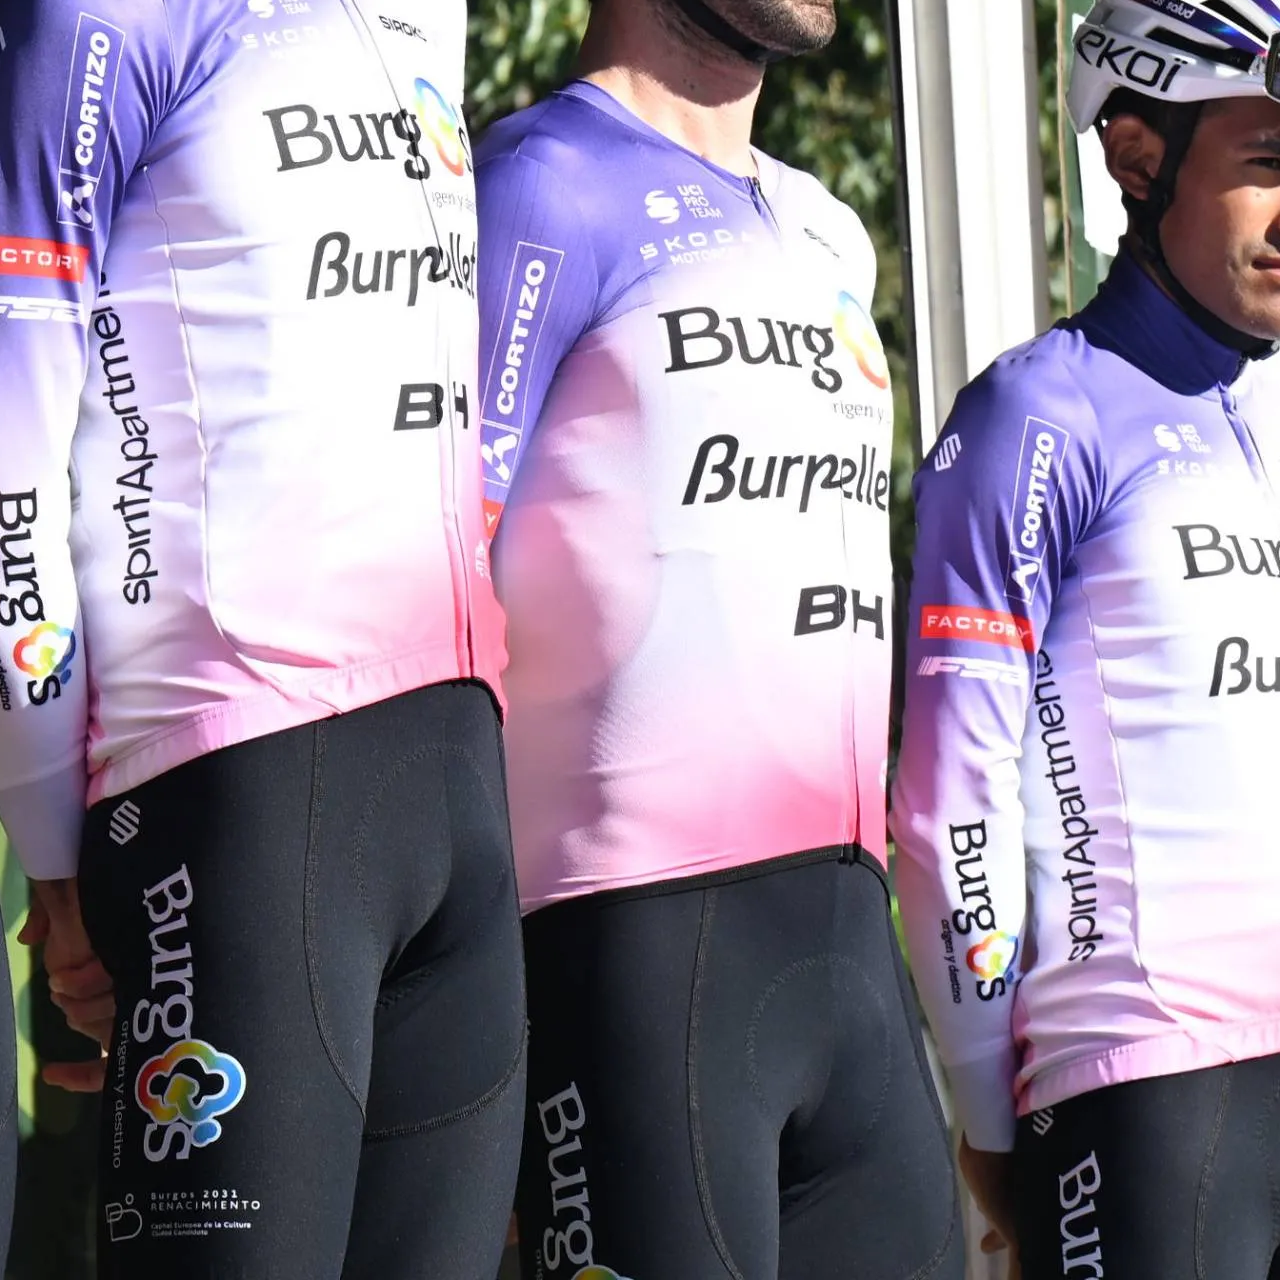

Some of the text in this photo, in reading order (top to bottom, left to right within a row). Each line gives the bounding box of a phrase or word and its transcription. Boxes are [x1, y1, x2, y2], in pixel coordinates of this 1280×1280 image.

[282, 0, 312, 17] TEAM
[1165, 0, 1197, 20] salud
[74, 31, 111, 167] CORTIZO
[676, 184, 705, 197] UCI
[682, 194, 710, 207] PRO
[688, 206, 724, 220] TEAM
[496, 258, 546, 415] CORTIZO
[1020, 431, 1056, 550] CORTIZO
[792, 582, 886, 641] BH
[948, 819, 1020, 1002] Burgos
[133, 862, 247, 1163] Burgos
[150, 1188, 239, 1203] Burgos 2031
[150, 1200, 262, 1212] RENACIMIENTO
